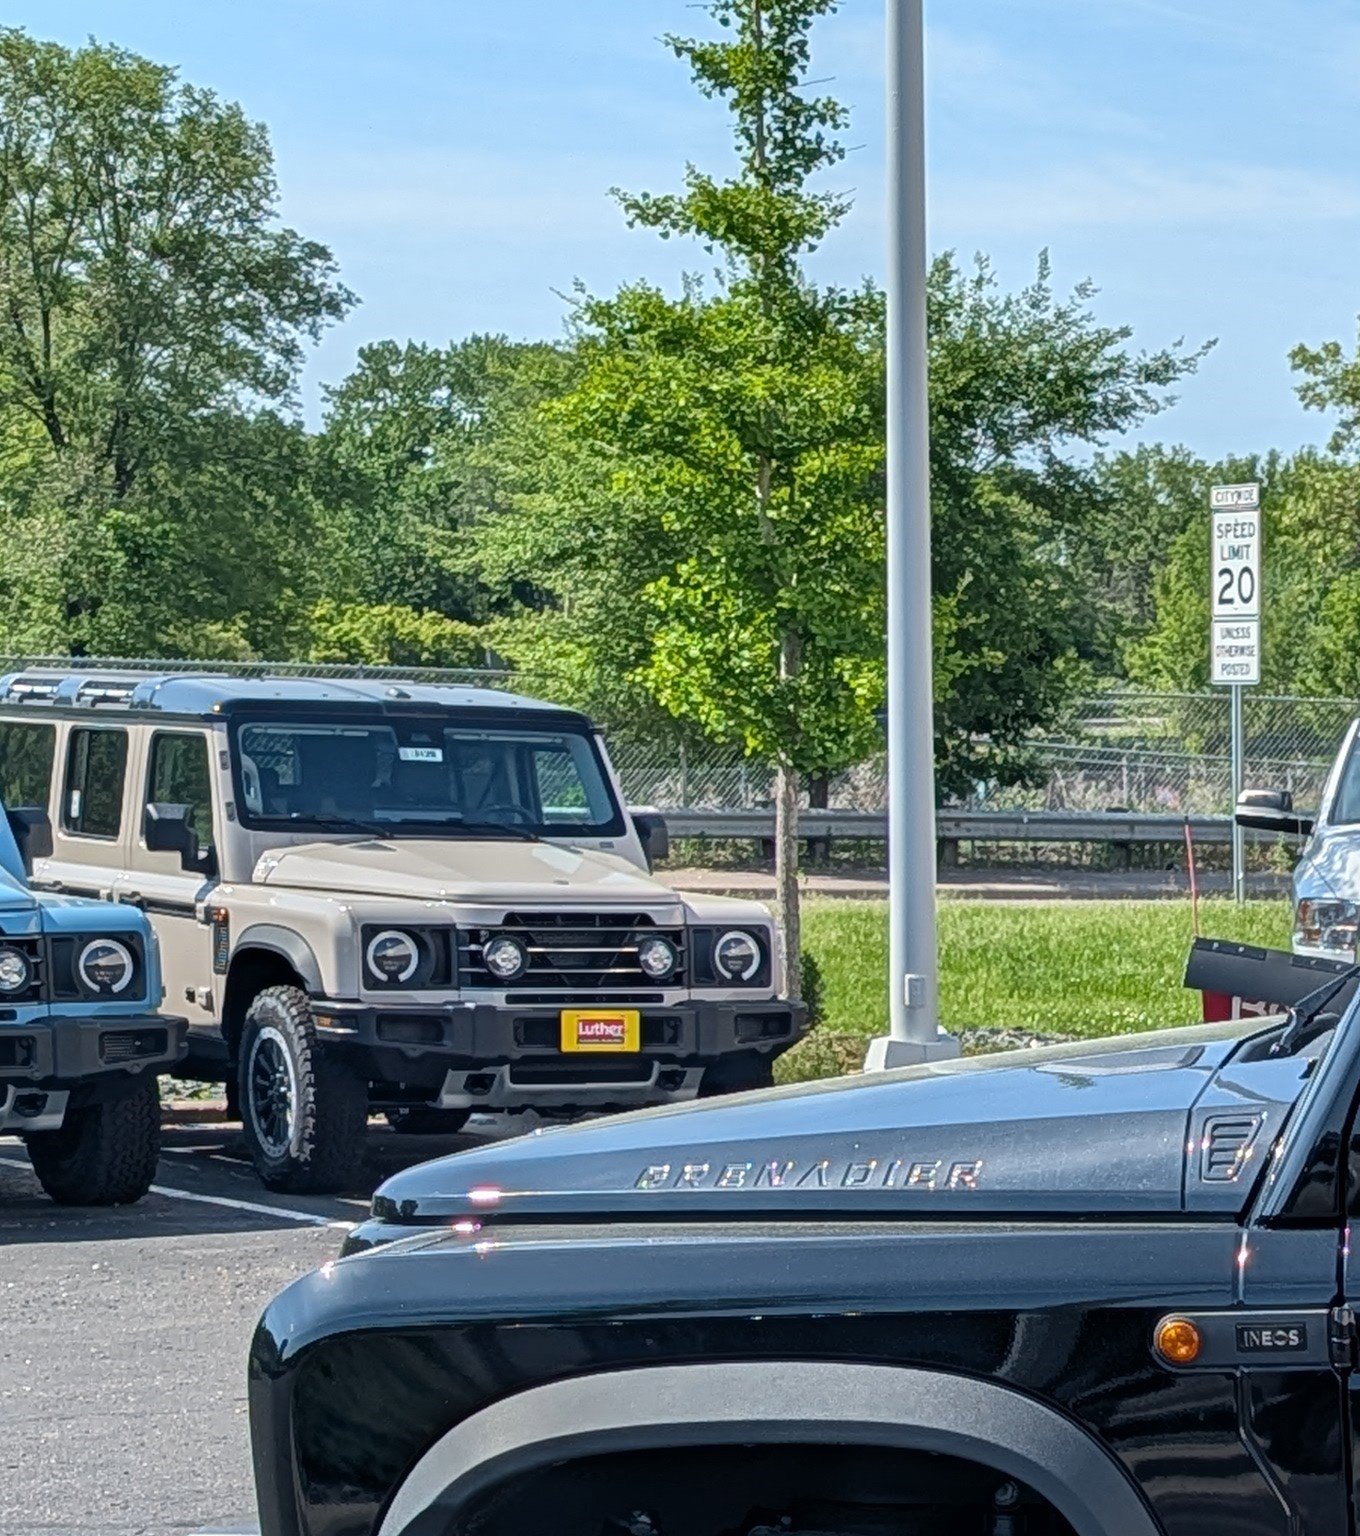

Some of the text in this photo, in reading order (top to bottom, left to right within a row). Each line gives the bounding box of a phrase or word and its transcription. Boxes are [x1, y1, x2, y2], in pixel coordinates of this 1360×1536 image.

[1215, 489, 1254, 503] CITYWIDE
[1216, 522, 1256, 539] SPEED
[1220, 544, 1251, 561] LIMIT
[1218, 566, 1255, 605] 20
[1220, 626, 1251, 639] UNLESS
[1216, 645, 1256, 657] OTHERWISE
[1220, 663, 1251, 676] POSTED
[578, 1021, 624, 1037] Luther
[1243, 1328, 1300, 1347] INEOS
